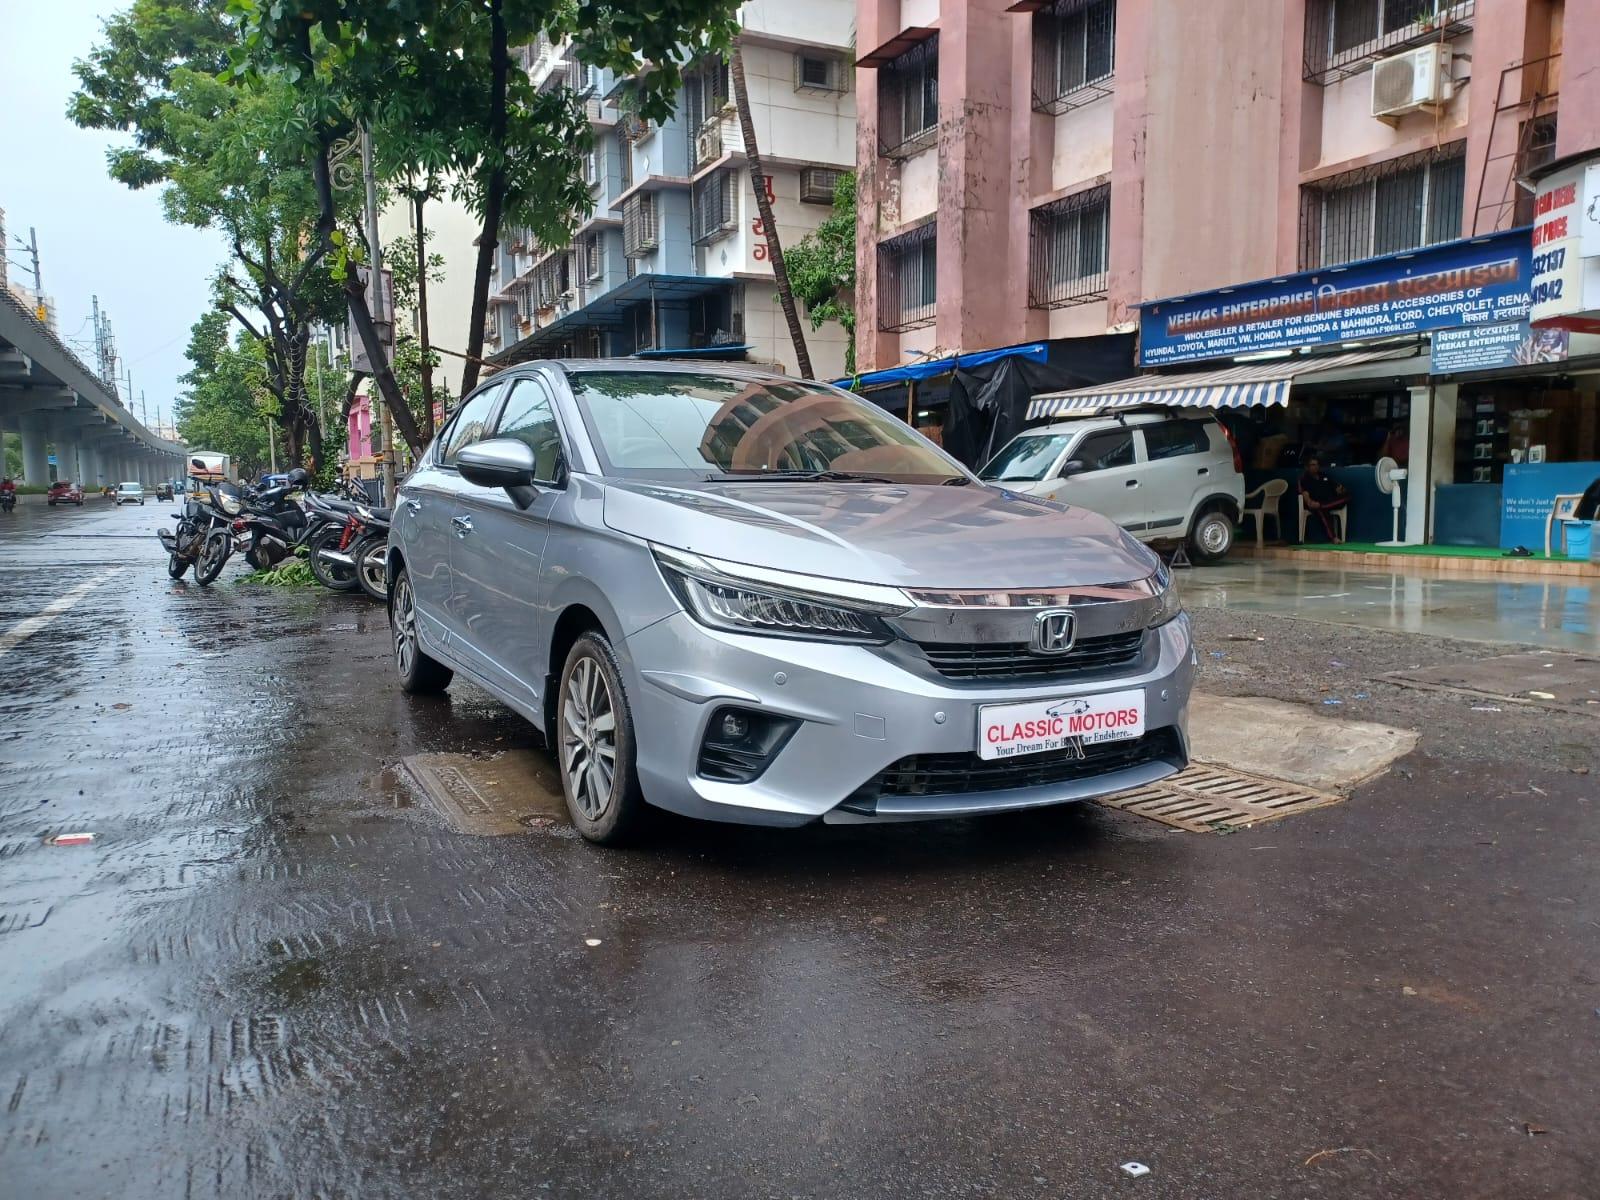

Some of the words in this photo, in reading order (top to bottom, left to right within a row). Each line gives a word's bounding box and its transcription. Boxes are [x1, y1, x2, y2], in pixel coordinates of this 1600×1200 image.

[1168, 307, 1218, 332] VEEKAS
[1222, 290, 1313, 321] ENTERPRISE
[1177, 342, 1206, 352] TOYOTA,
[1208, 336, 1237, 348] MARUTI,
[1254, 329, 1282, 341] HONDA
[1286, 323, 1331, 337] MAHINDRA
[1332, 321, 1339, 330] &
[1341, 314, 1392, 330] MAHINDRA,
[1395, 309, 1424, 322] FORD,
[1428, 298, 1494, 317] CHEVROLET,
[1498, 292, 1532, 307] RENA
[1184, 326, 1237, 341] WHOLESELLER
[1238, 325, 1244, 333] &
[1246, 319, 1283, 331] RETAILER
[1285, 315, 1302, 326] FOR
[1304, 310, 1342, 323] GENUINE
[1344, 305, 1380, 318] SPARES
[1382, 302, 1389, 311] &
[1391, 290, 1464, 310] ACCESSORIES
[1467, 287, 1483, 298] OF
[1436, 340, 1466, 351] VEEKAS
[1469, 333, 1521, 347] ENTERPRISE
[987, 717, 1063, 743] CLASSIC
[1069, 708, 1138, 733] MOTORS
[996, 745, 1015, 756] Your
[1016, 743, 1043, 754] Dream
[1045, 739, 1059, 749] For
